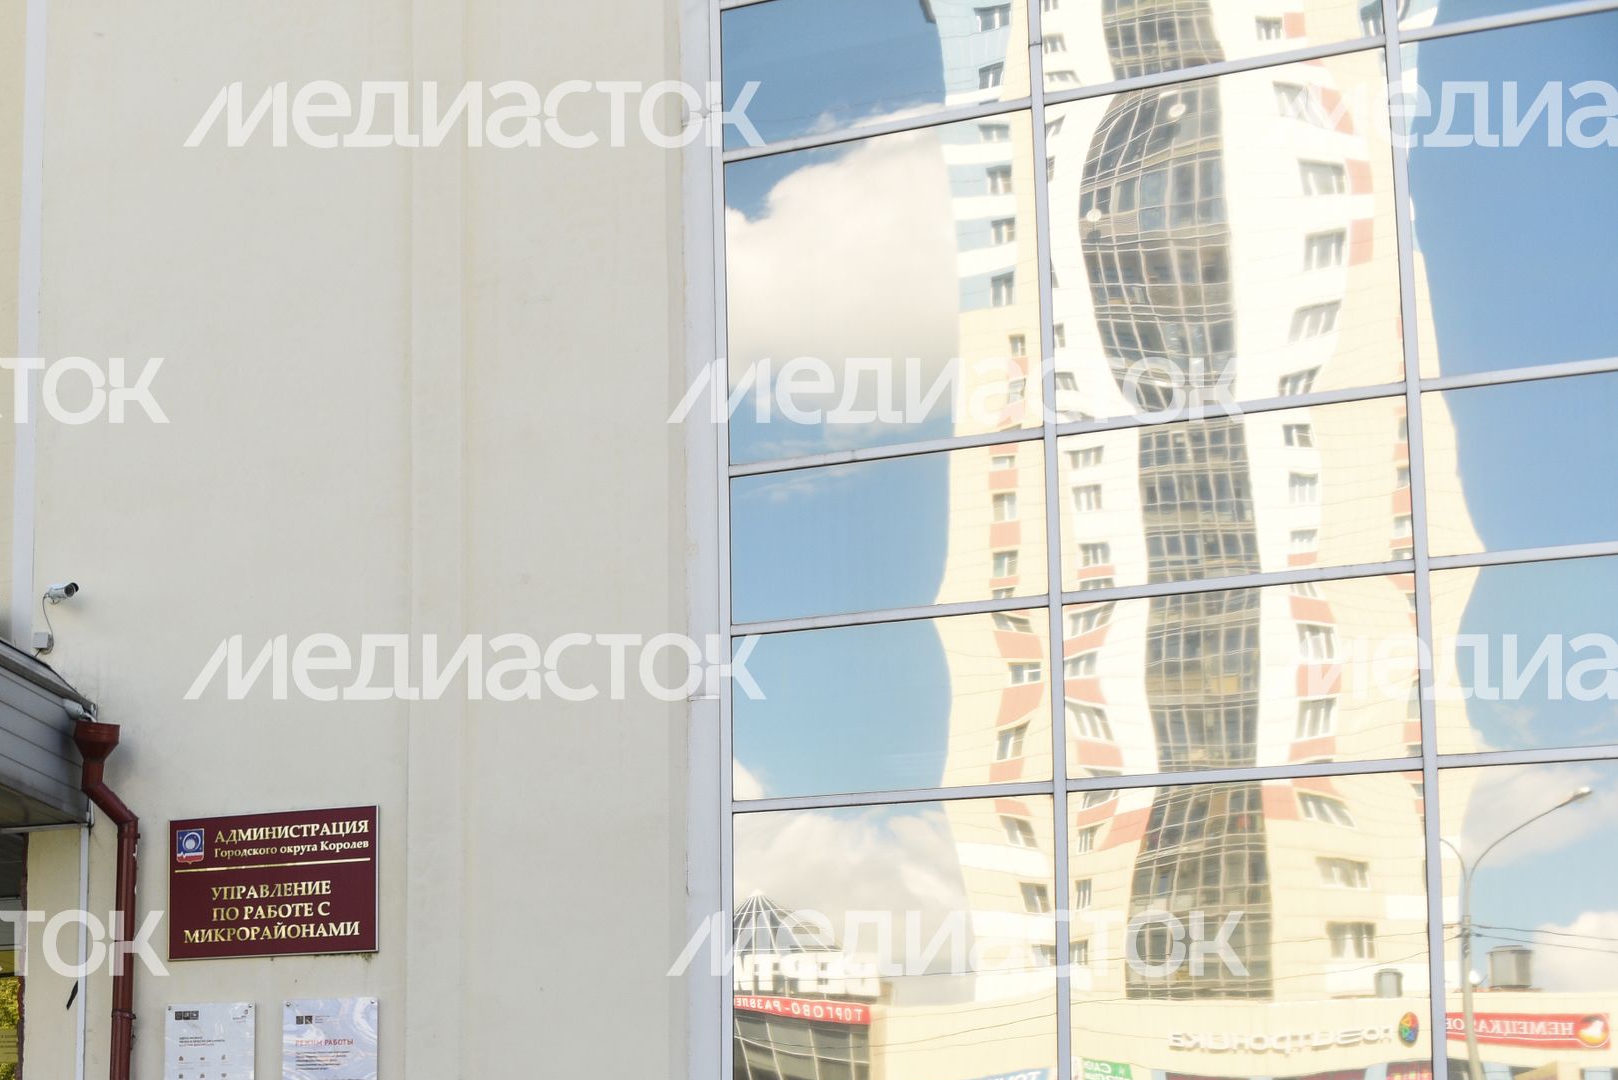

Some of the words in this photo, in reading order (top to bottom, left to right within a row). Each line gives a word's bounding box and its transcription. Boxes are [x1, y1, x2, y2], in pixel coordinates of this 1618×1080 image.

[214, 819, 369, 844] АДМИНИСТРАЦИЯ
[214, 846, 277, 860] Городского
[280, 845, 318, 857] округа
[320, 840, 369, 853] Королев
[211, 880, 332, 901] УПРАВЛЕНИЕ
[212, 906, 239, 922] ПО
[243, 902, 314, 921] РАБОТЕ
[317, 901, 331, 916] С
[184, 920, 360, 944] МИКРОРАЙОНАМИ
